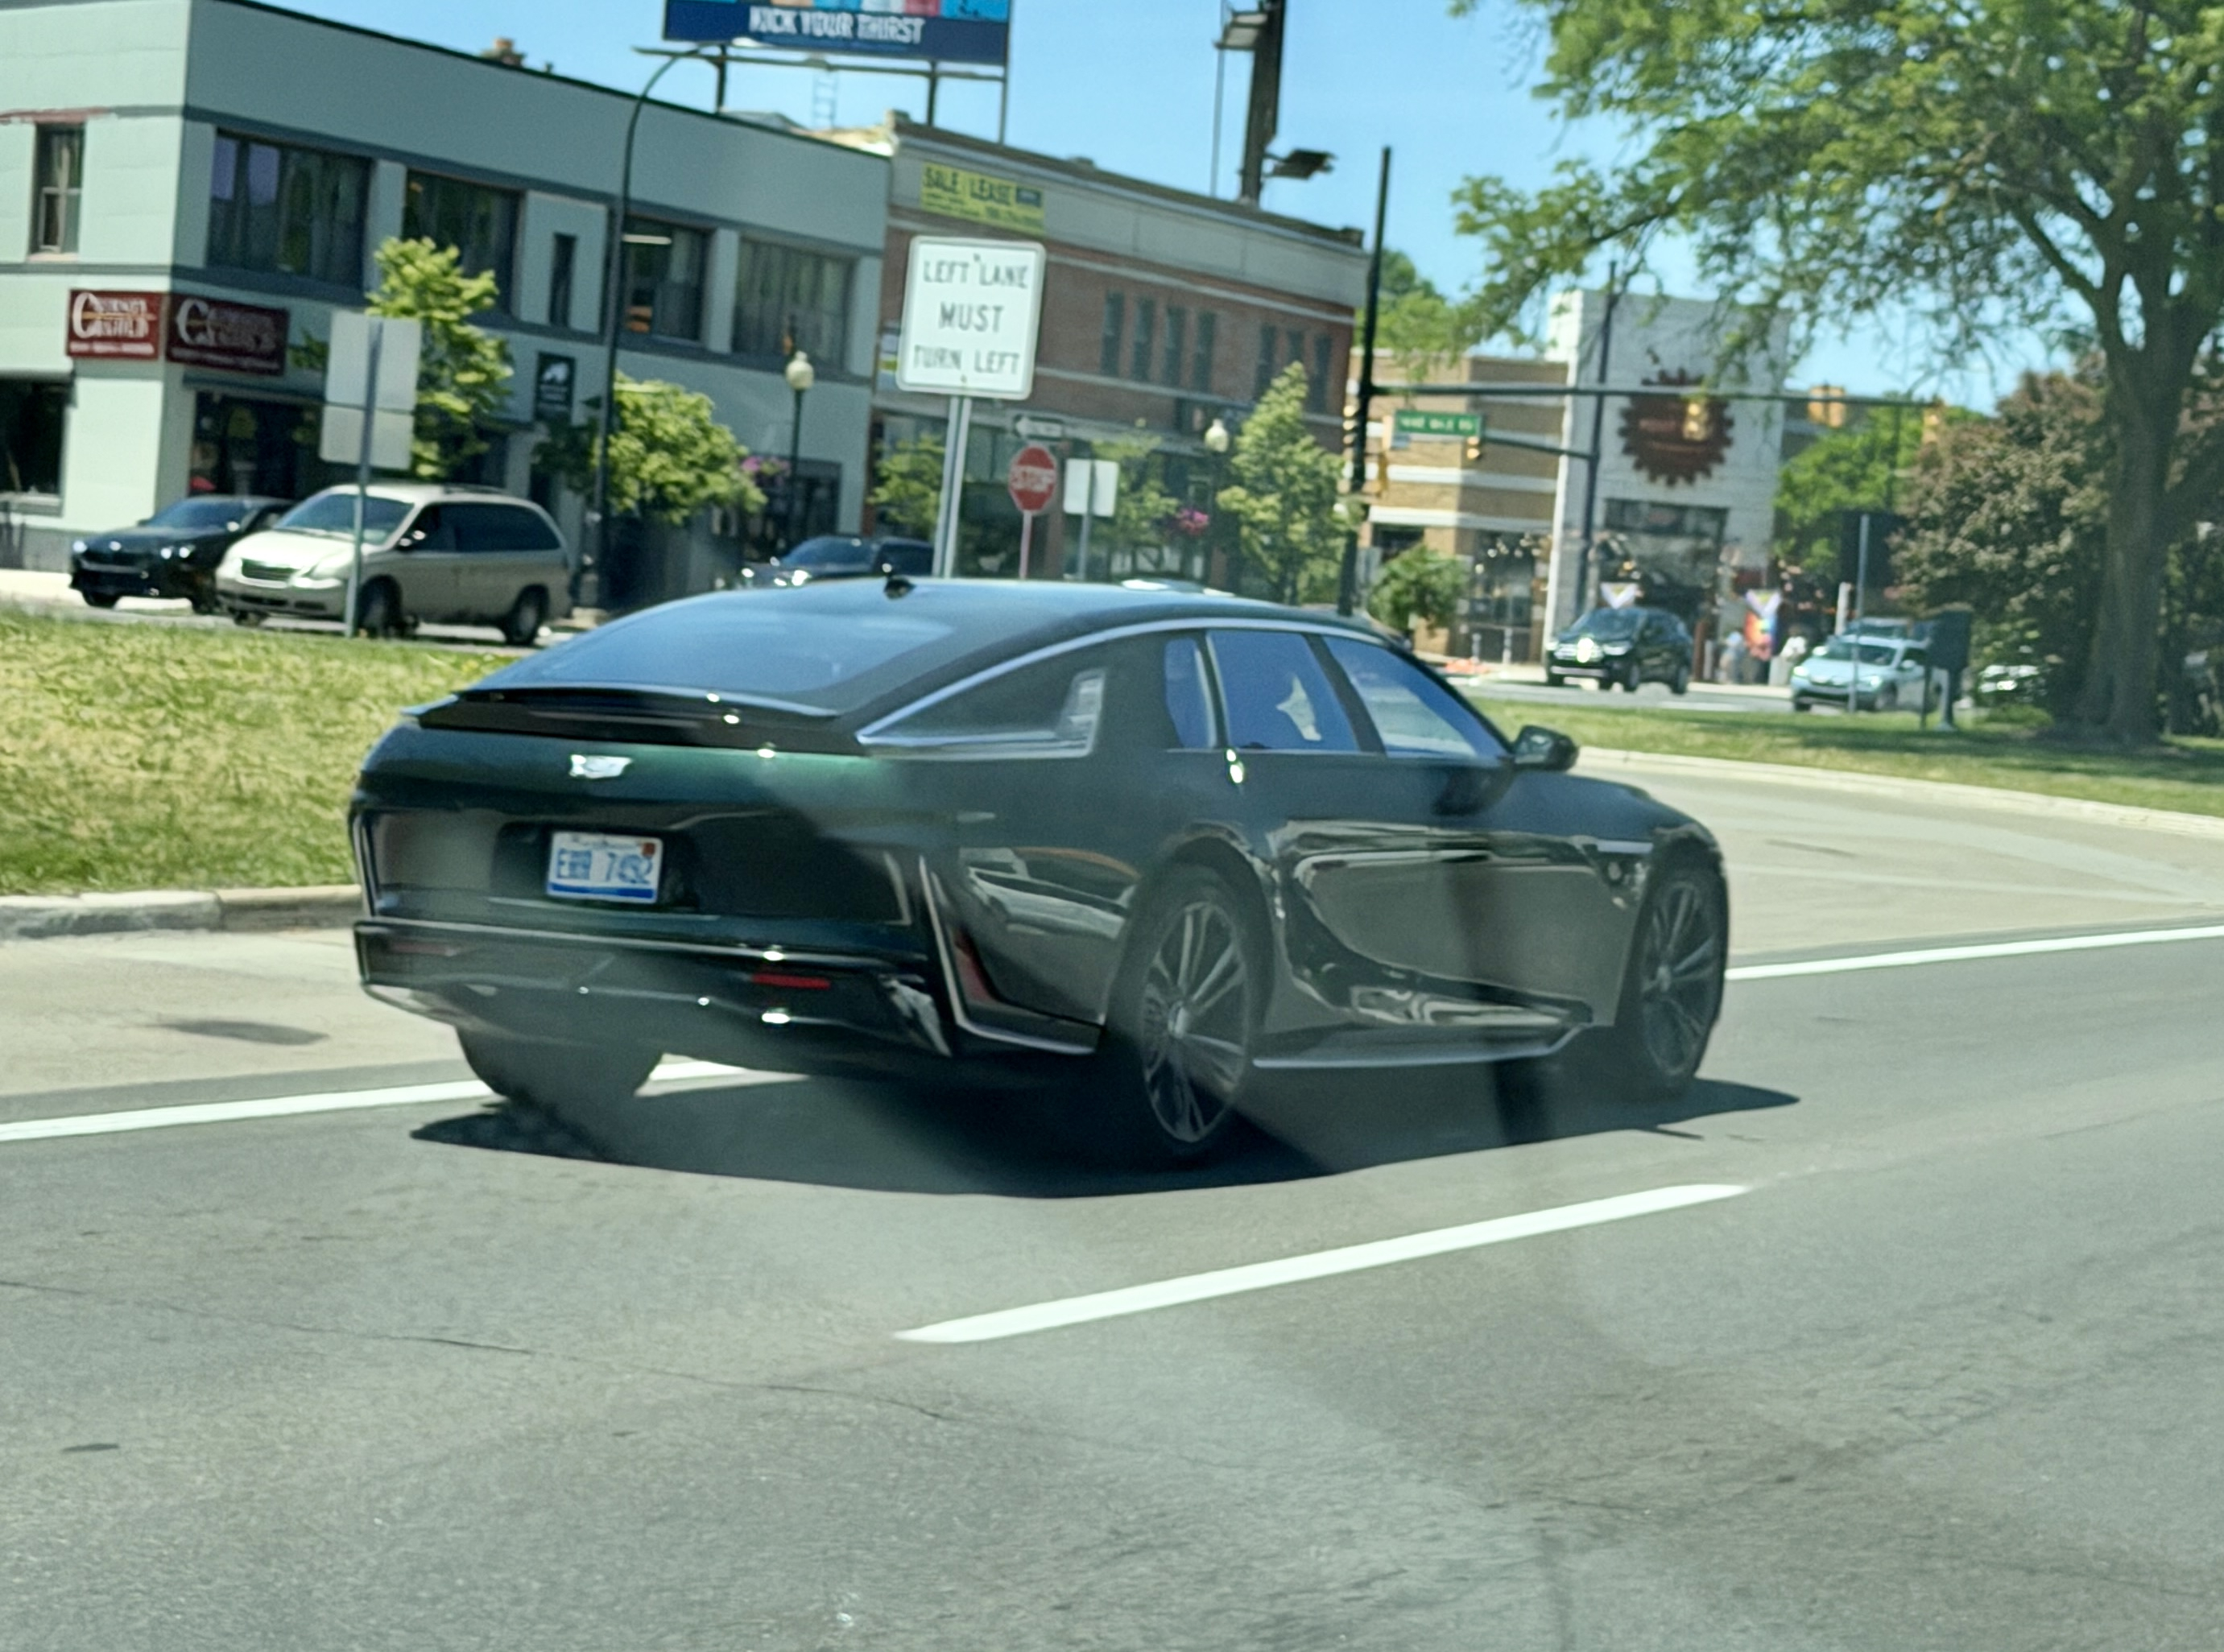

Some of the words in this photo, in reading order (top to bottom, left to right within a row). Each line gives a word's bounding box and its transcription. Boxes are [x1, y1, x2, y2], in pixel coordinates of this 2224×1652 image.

[801, 11, 854, 38] YOUR
[857, 14, 925, 43] THIRST
[924, 259, 969, 283] LEFT
[979, 263, 1028, 289] LANE
[939, 301, 1004, 332] MUST
[914, 345, 962, 370] TURN
[974, 349, 1020, 374] LEFT
